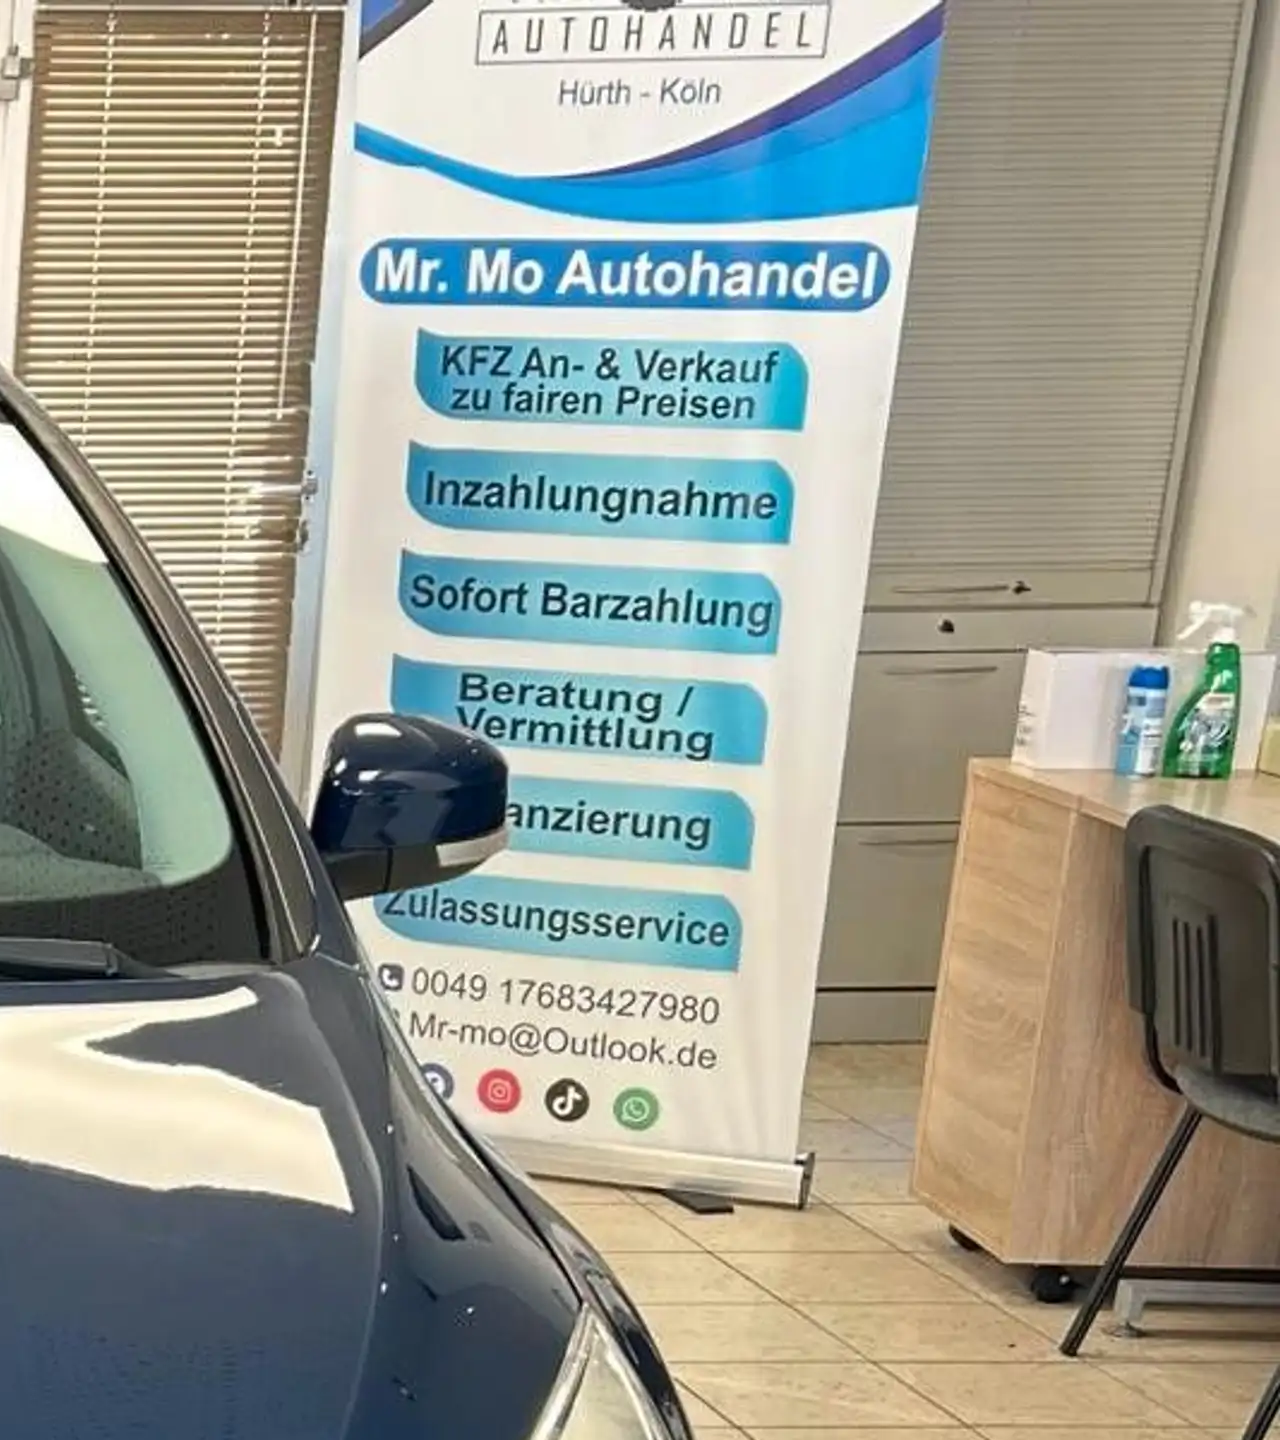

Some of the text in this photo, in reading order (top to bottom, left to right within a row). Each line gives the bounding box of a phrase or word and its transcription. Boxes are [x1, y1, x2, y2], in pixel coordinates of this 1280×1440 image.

[492, 12, 812, 54] AUTOHANDEL
[558, 79, 632, 107] Hürth
[660, 77, 722, 105] Köln
[374, 247, 879, 300] Mr. Mo Autohandel
[441, 345, 781, 385] KFZ An- & Verkauf
[452, 382, 757, 419] zu fairen Preisen
[424, 470, 778, 523] Inzahlungnahme
[410, 574, 774, 637] Sofort Barzahlung
[458, 672, 695, 723] Beratung /
[456, 705, 715, 761] Vermittlung
[507, 800, 712, 850] anzierung
[382, 887, 730, 947] Zulassungsservice
[412, 967, 721, 1026] 0049 17683427980
[408, 1010, 719, 1069] Mr-mo@Outlook.de
